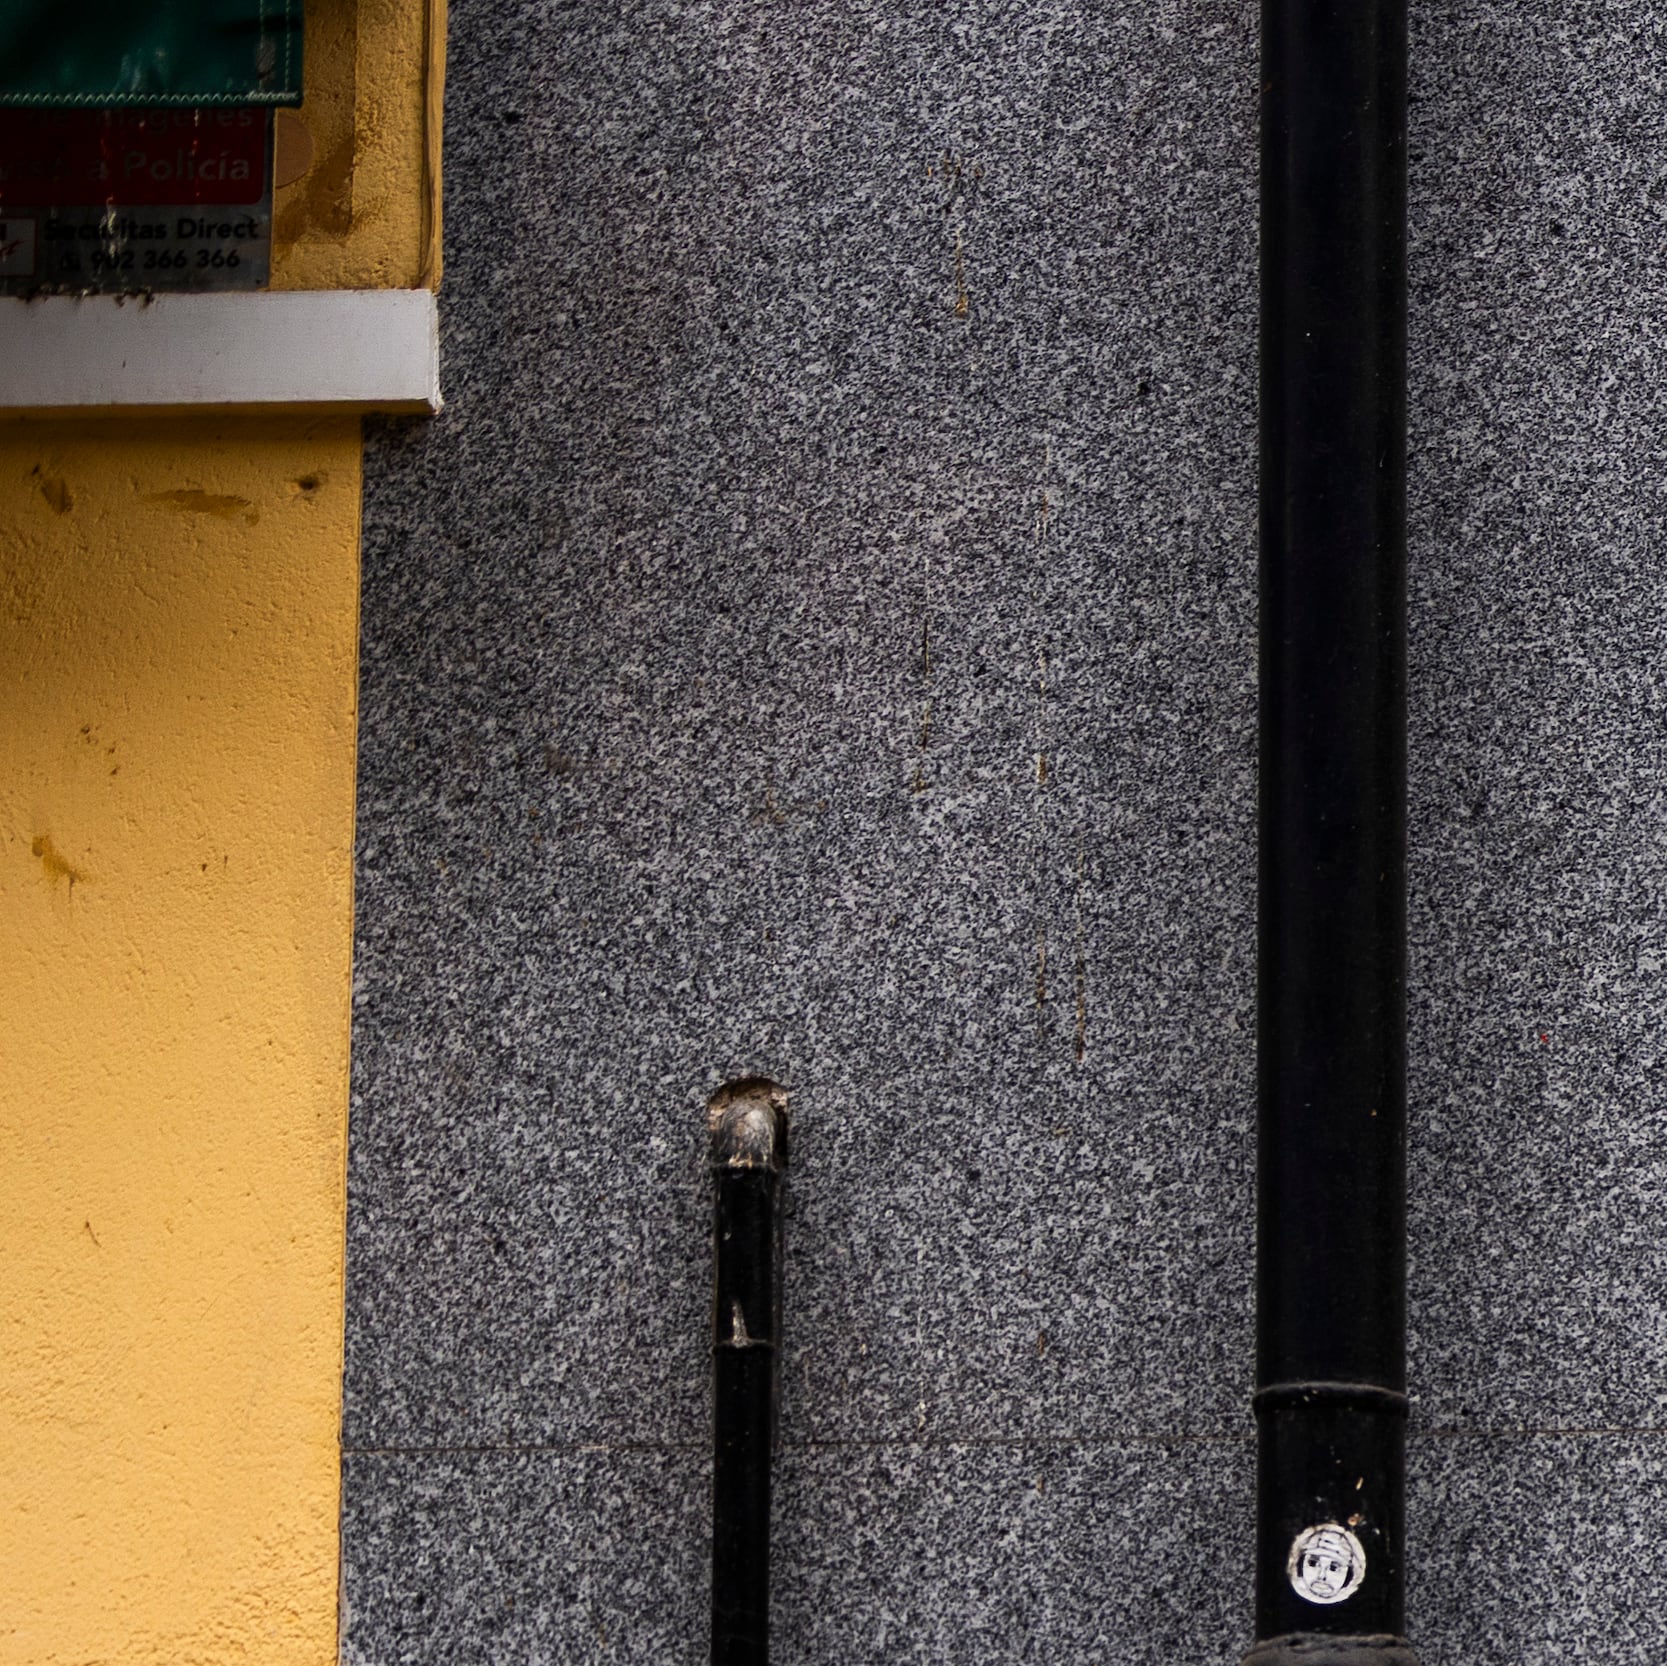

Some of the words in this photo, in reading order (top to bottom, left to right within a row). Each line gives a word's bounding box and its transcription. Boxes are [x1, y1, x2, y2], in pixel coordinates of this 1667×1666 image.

[123, 147, 251, 182] Policía
[177, 217, 259, 239] Direct
[143, 249, 188, 269] 366
[196, 248, 241, 269] 366
